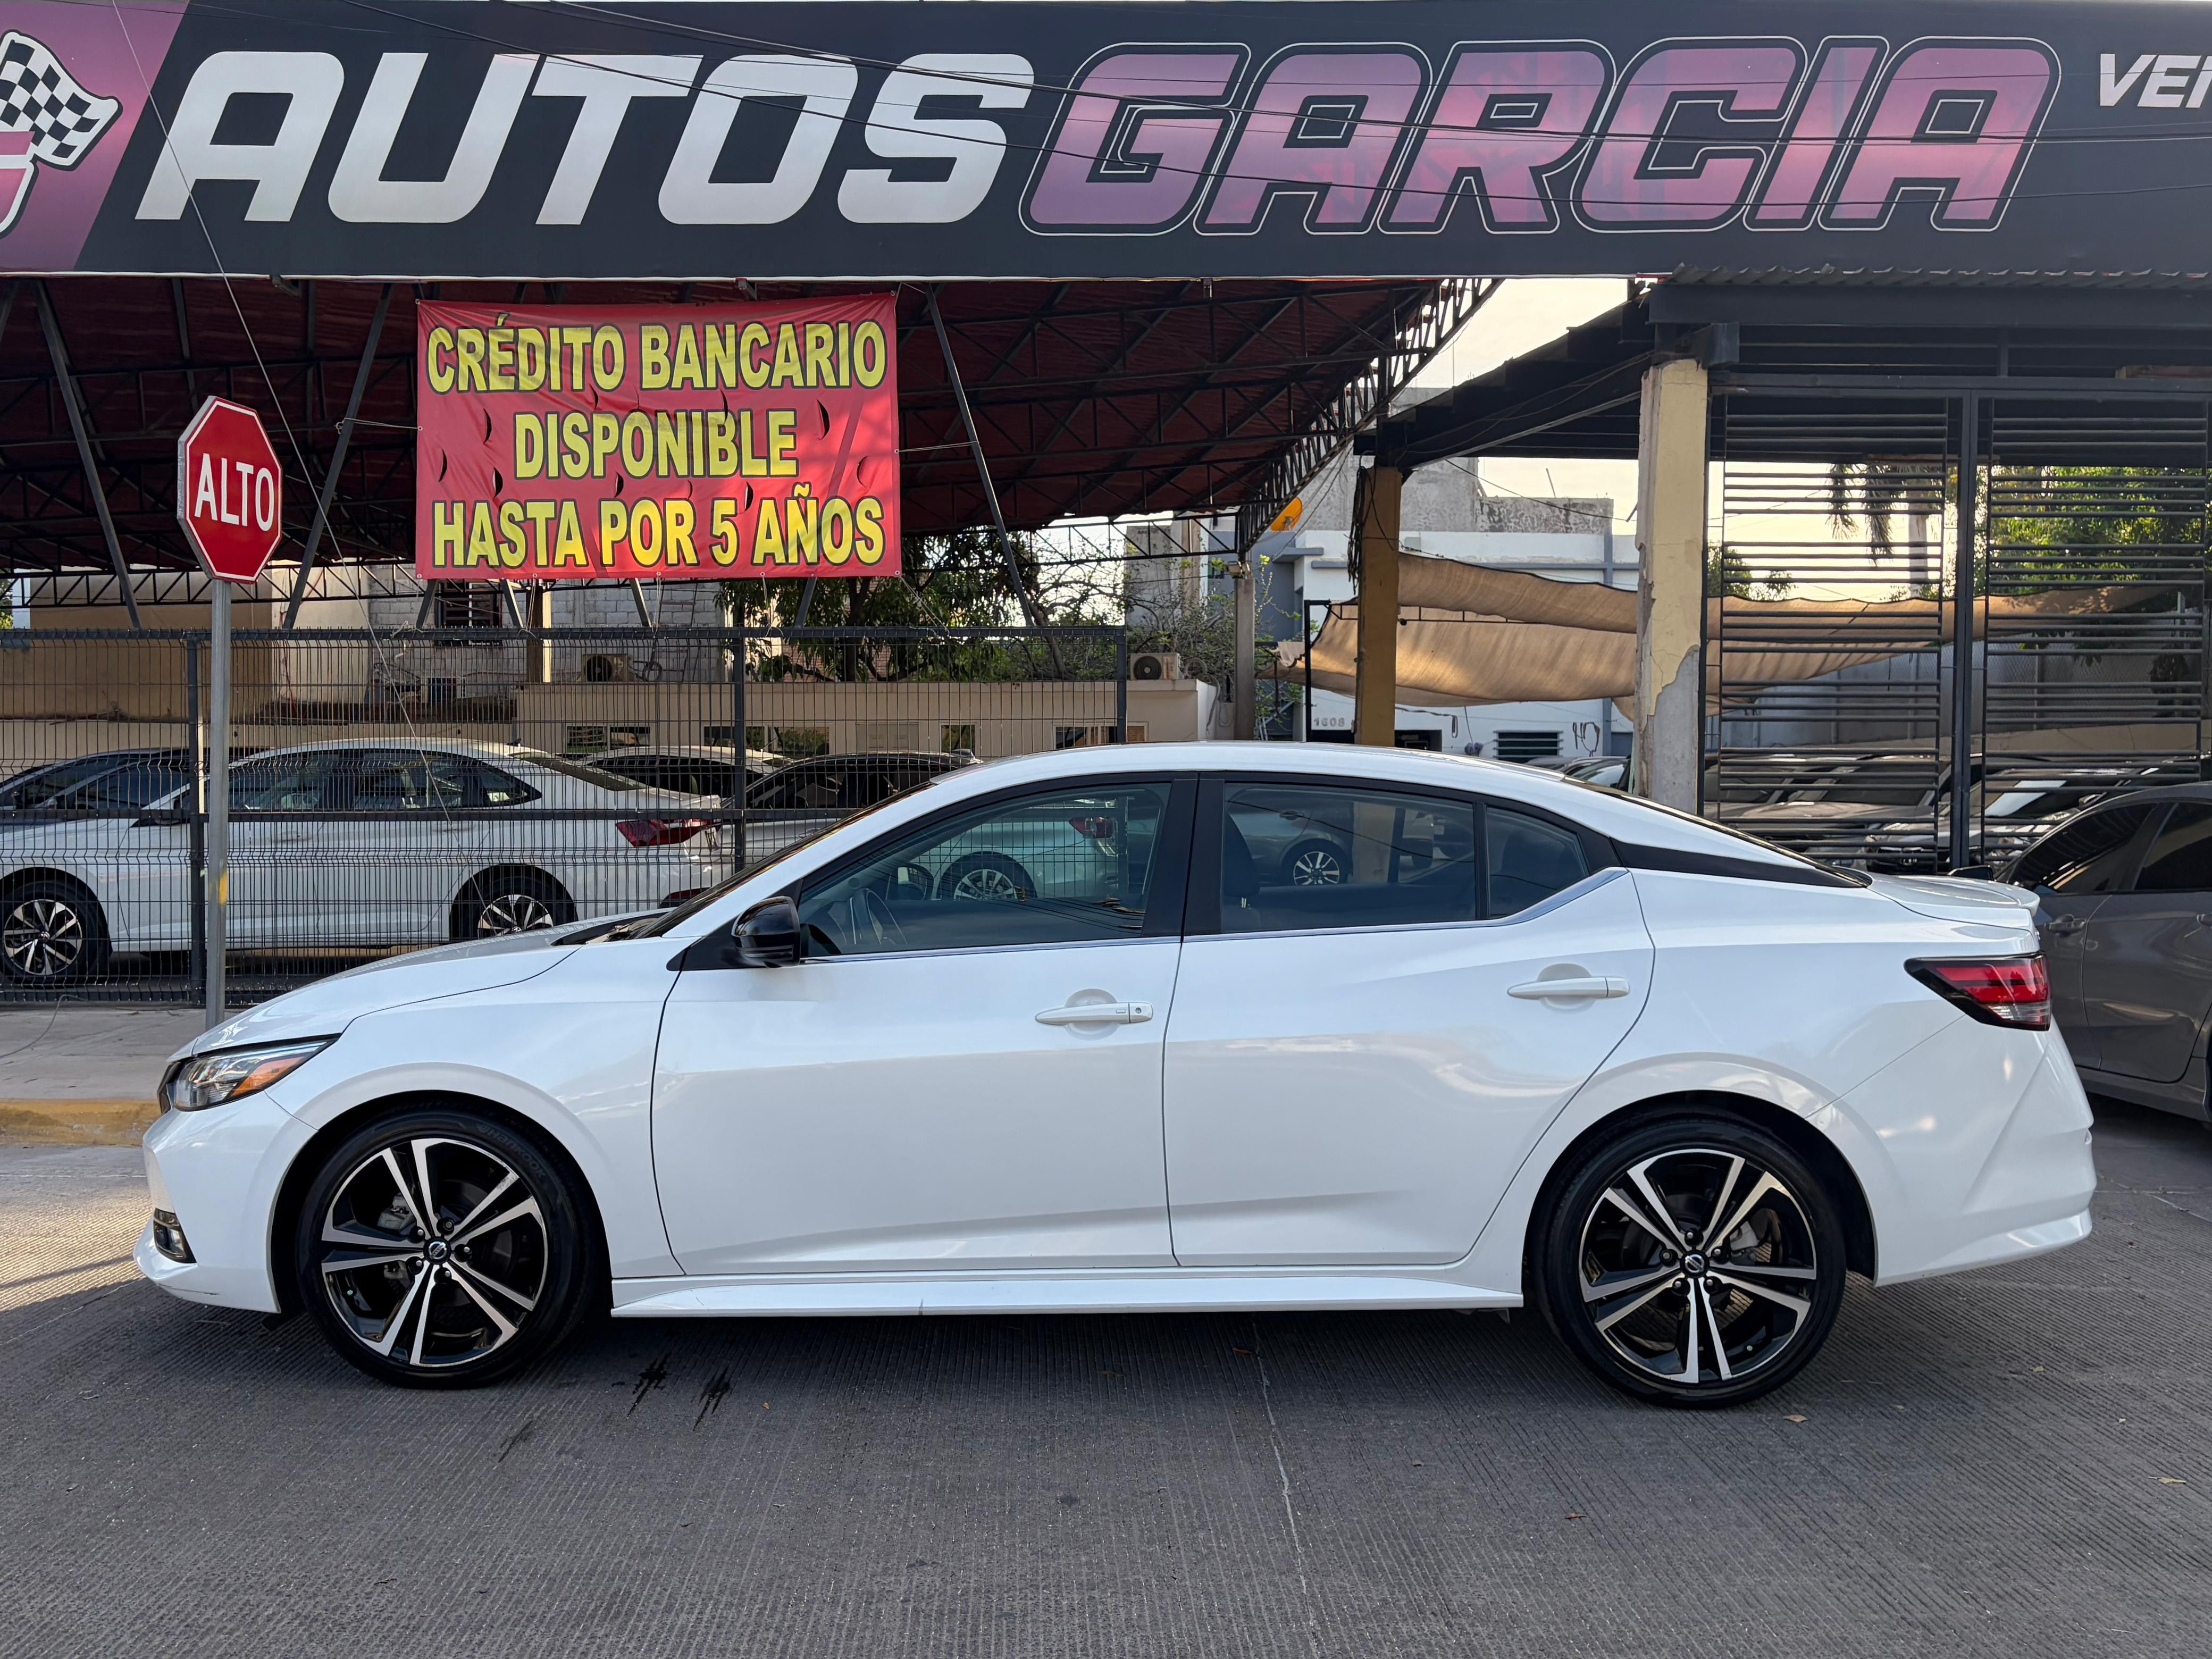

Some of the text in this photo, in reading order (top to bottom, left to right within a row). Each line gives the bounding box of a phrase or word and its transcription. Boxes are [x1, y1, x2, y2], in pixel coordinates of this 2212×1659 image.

[135, 51, 1035, 225] AUTOS
[1019, 36, 2061, 235] GARCIA
[427, 313, 887, 393] CRÉDITO BANCARIO
[513, 408, 799, 480] DISPONIBLE
[195, 453, 274, 531] ALTO
[432, 481, 886, 569] HASTA POR 5 AÑOS
